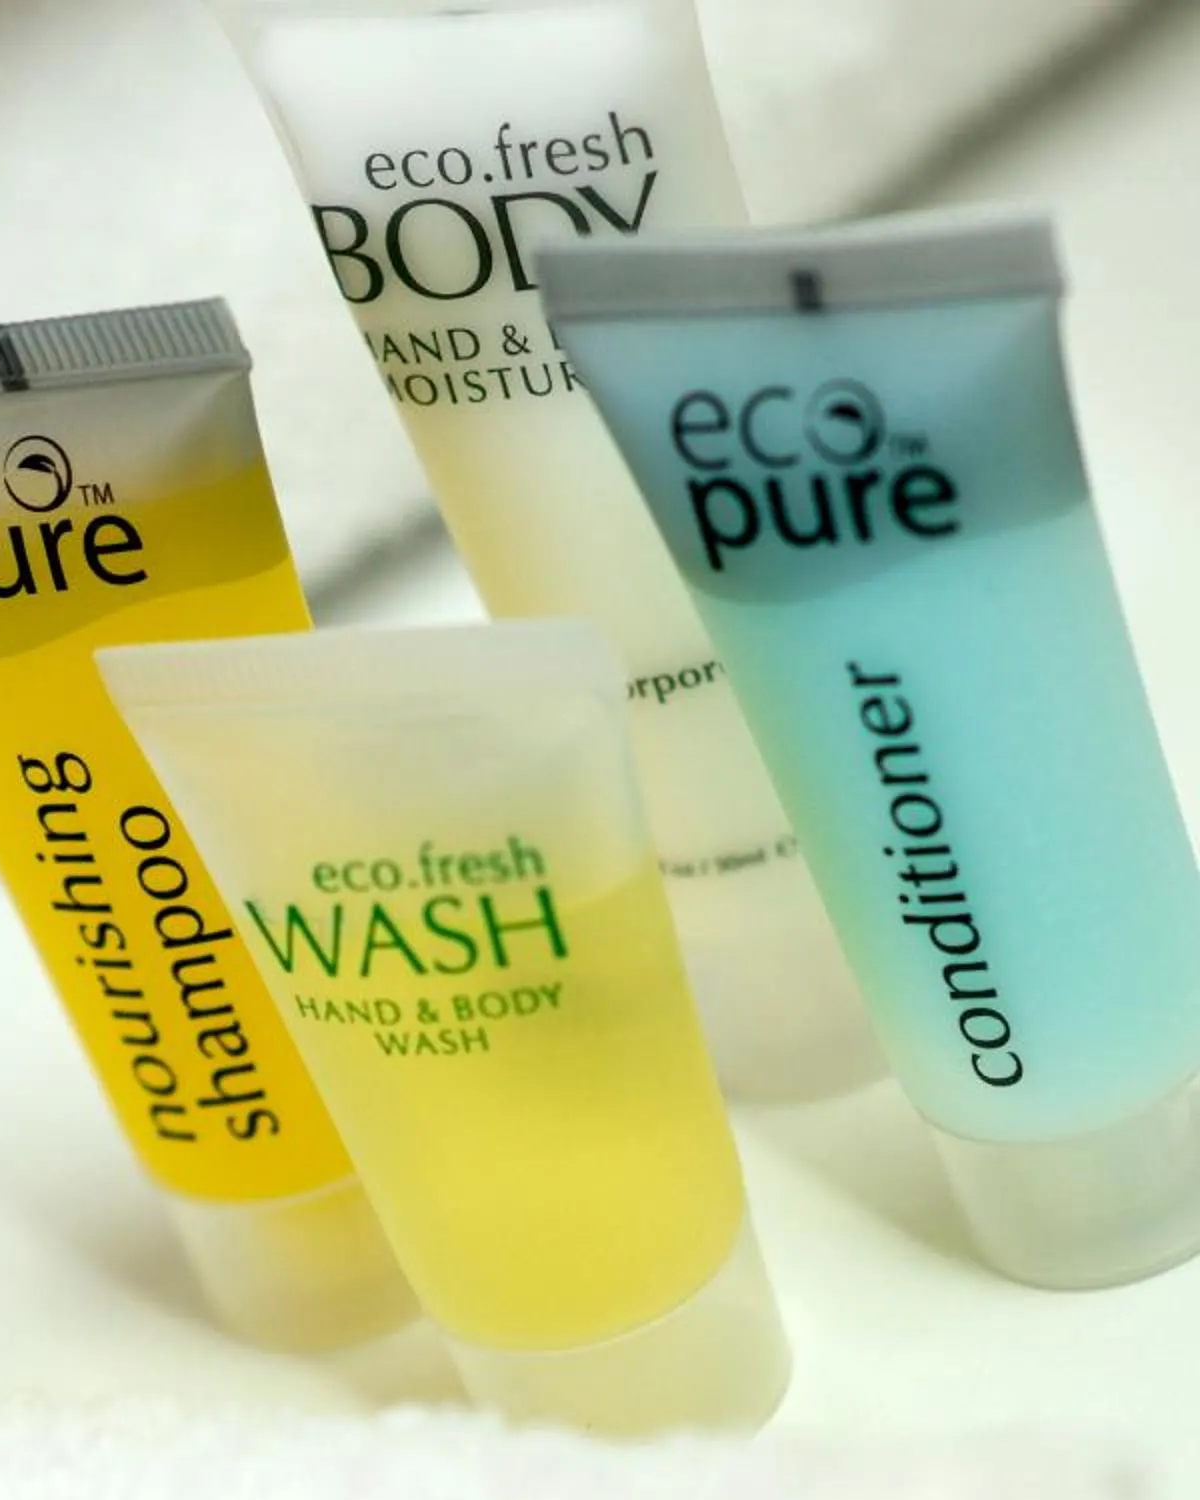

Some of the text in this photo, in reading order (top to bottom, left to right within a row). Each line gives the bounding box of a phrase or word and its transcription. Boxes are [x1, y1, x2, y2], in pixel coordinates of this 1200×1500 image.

[364, 111, 653, 190] eco.fresh
[501, 324, 531, 355] &
[685, 464, 961, 573] pure
[627, 660, 726, 704] rpor
[312, 835, 546, 893] eco.fresh
[845, 660, 1023, 1088] conditioner
[17, 751, 197, 1142] nourishing
[244, 886, 568, 978] WASH
[119, 805, 280, 1141] shampoo
[295, 981, 563, 1027] HAND & BODY
[374, 1027, 491, 1056] WASH
